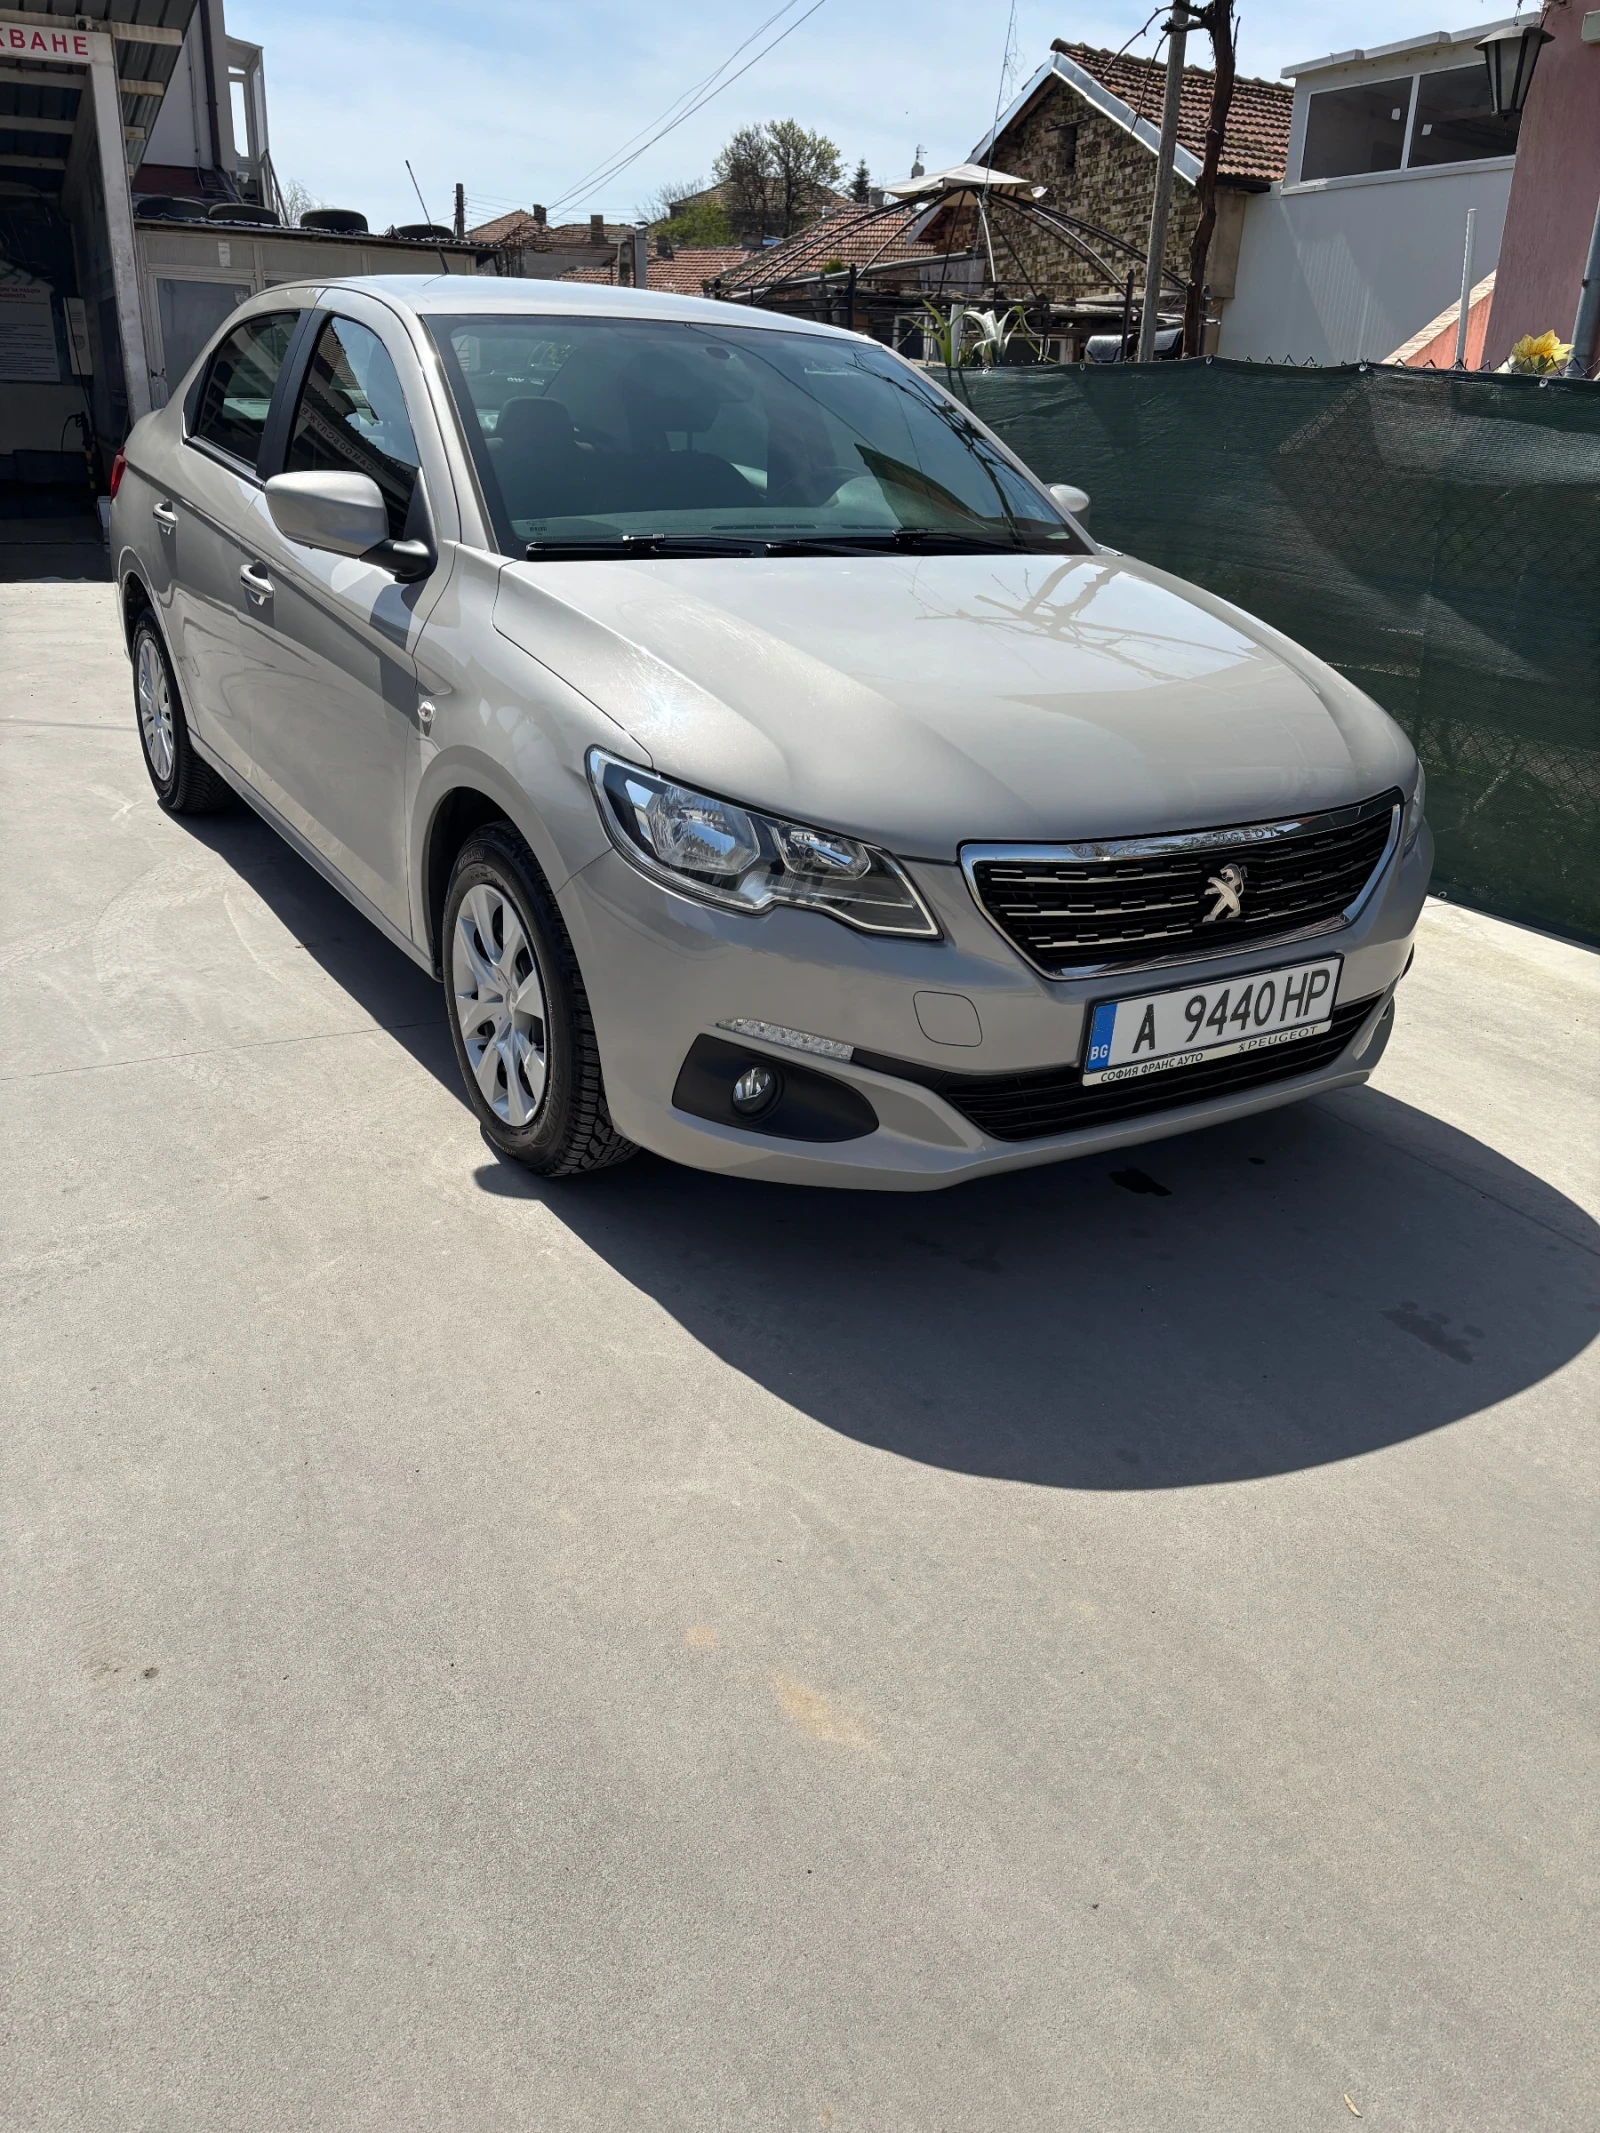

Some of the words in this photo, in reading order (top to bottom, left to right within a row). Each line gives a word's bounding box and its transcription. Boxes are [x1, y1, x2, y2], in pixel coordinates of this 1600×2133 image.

[1190, 826, 1277, 847] PEUGEOT
[1131, 1003, 1156, 1054] A
[1184, 980, 1276, 1043] 9440
[1280, 969, 1331, 1022] HP
[1248, 1025, 1319, 1050] PEUGEOT
[1090, 1044, 1109, 1061] BG
[1100, 1066, 1139, 1083] СОФИЯ
[1141, 1058, 1175, 1075] ФРАНС
[1176, 1052, 1204, 1067] АУТО
